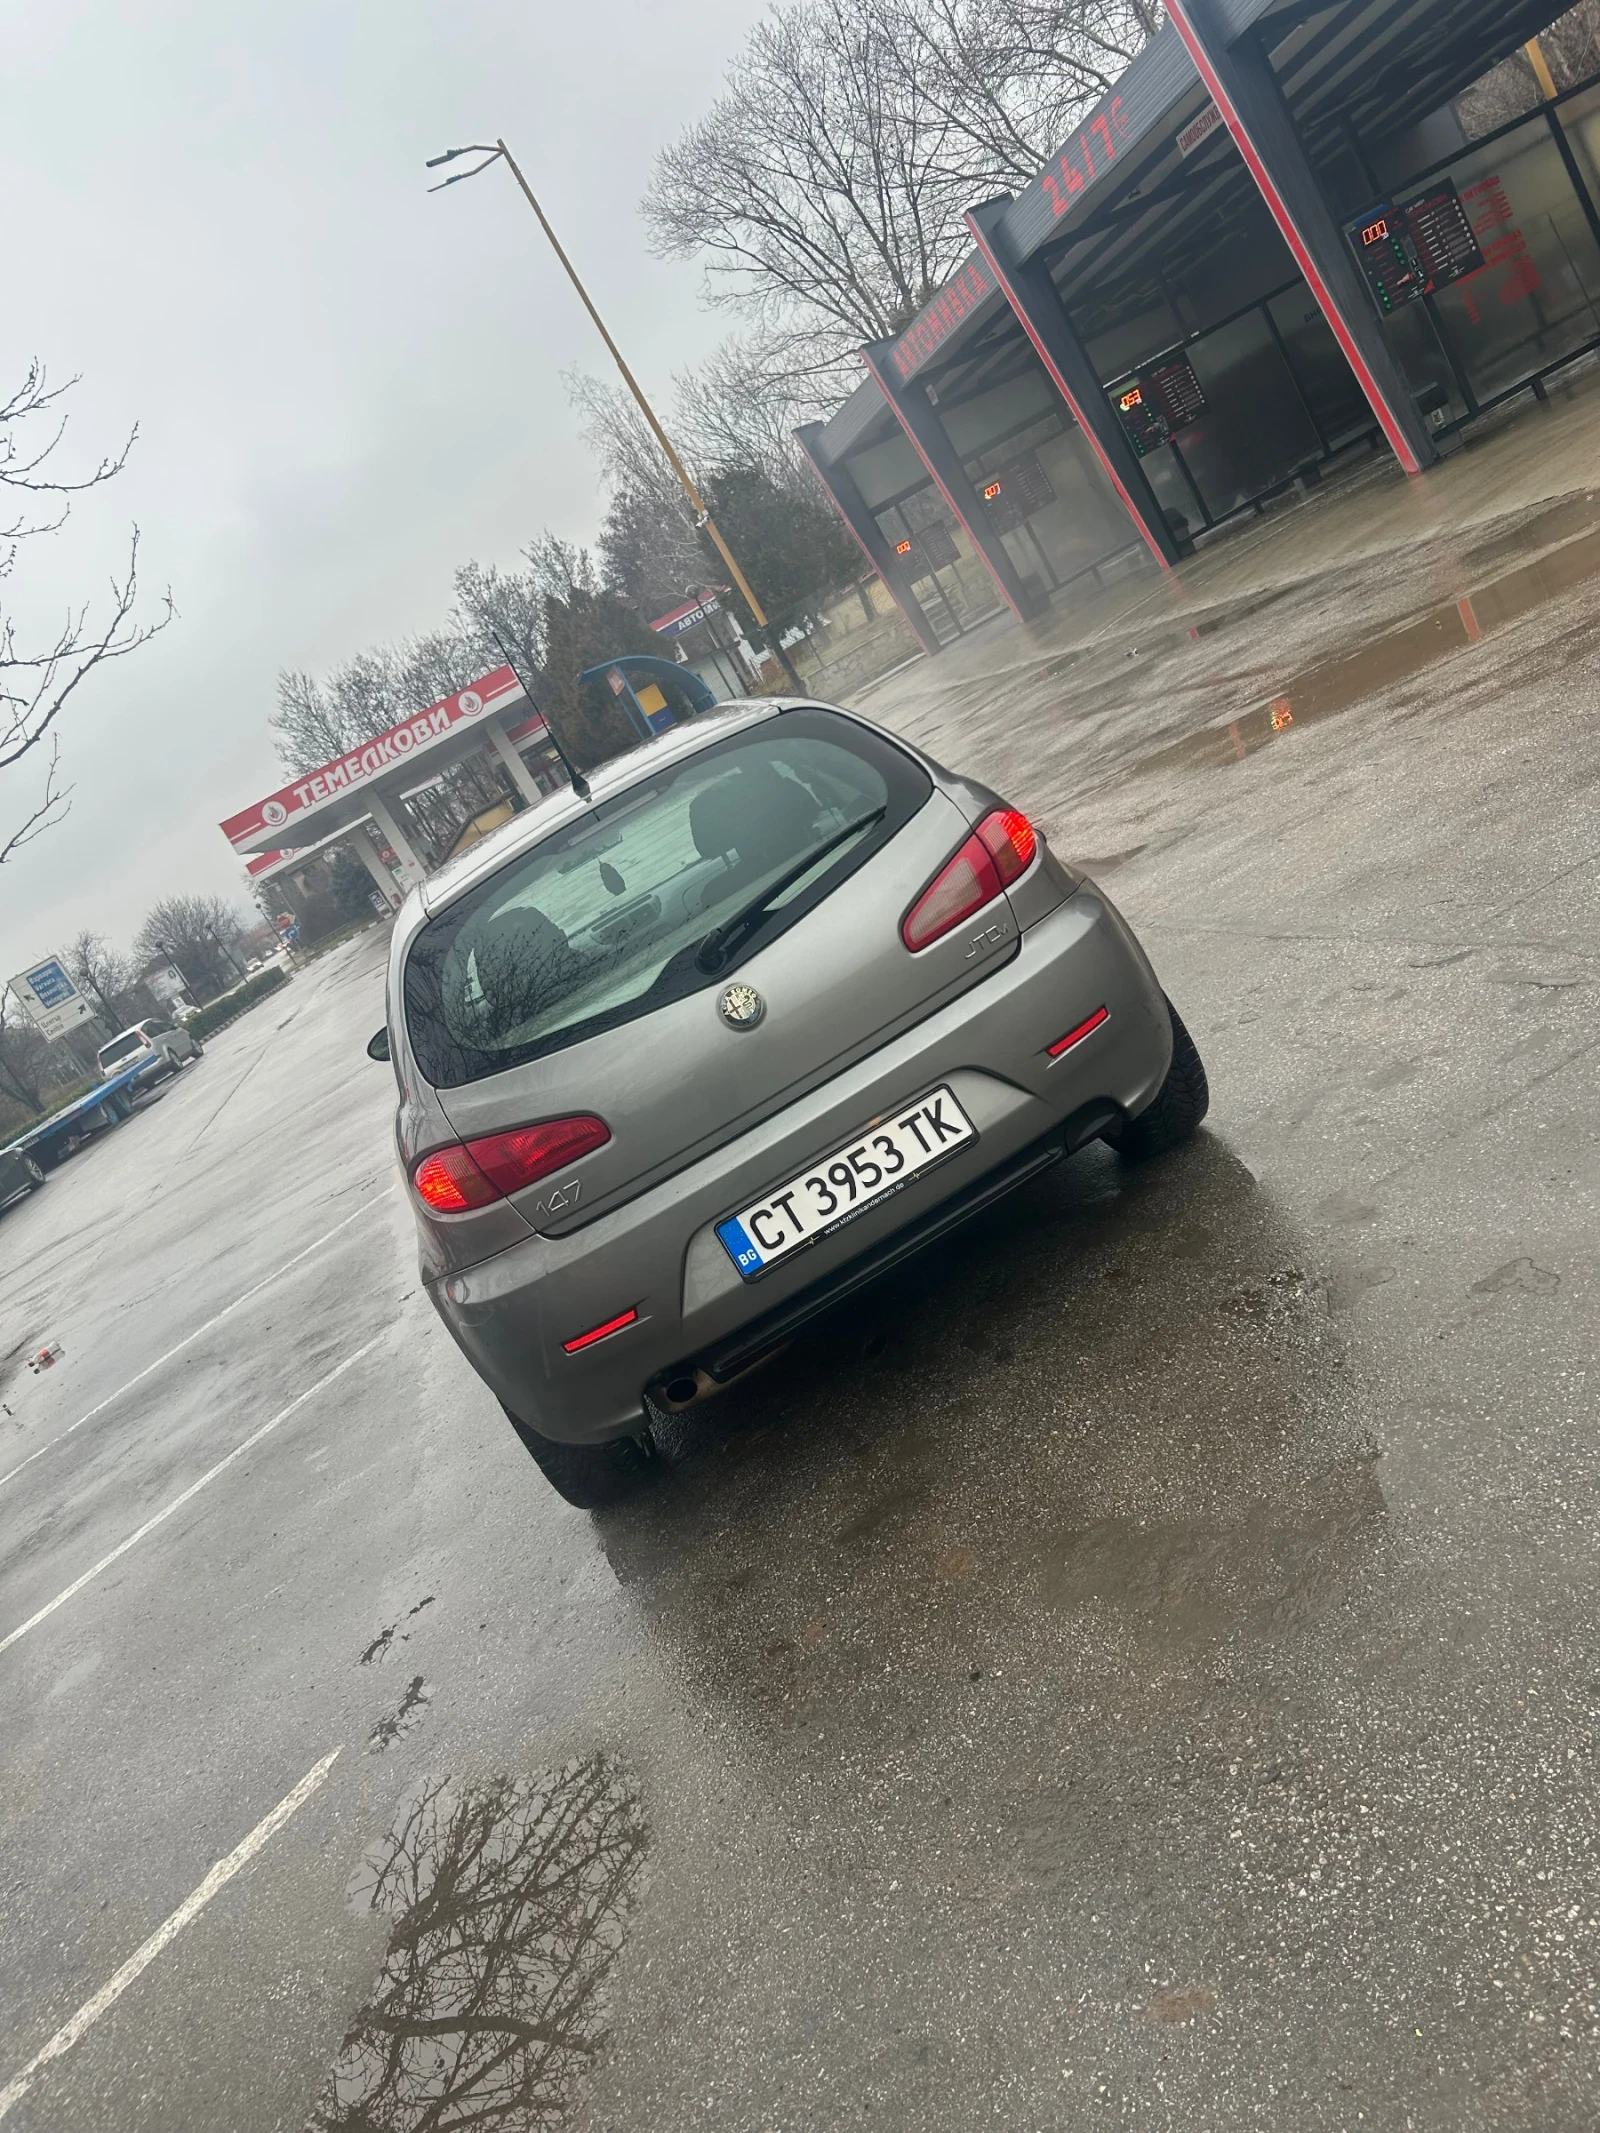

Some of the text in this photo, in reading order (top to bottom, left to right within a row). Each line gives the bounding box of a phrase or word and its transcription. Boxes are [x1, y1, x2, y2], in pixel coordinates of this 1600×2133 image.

[1042, 112, 1116, 217] 24/7
[1362, 220, 1387, 246] 000
[892, 263, 989, 379] АВТОМИВКА
[293, 707, 453, 810] ТЕМЕЛКОВИ
[34, 977, 56, 991] Varvara
[46, 1023, 65, 1036] Centre
[749, 1097, 963, 1250] CT 3953 TK
[535, 1179, 582, 1217] 147
[738, 1248, 757, 1267] BG
